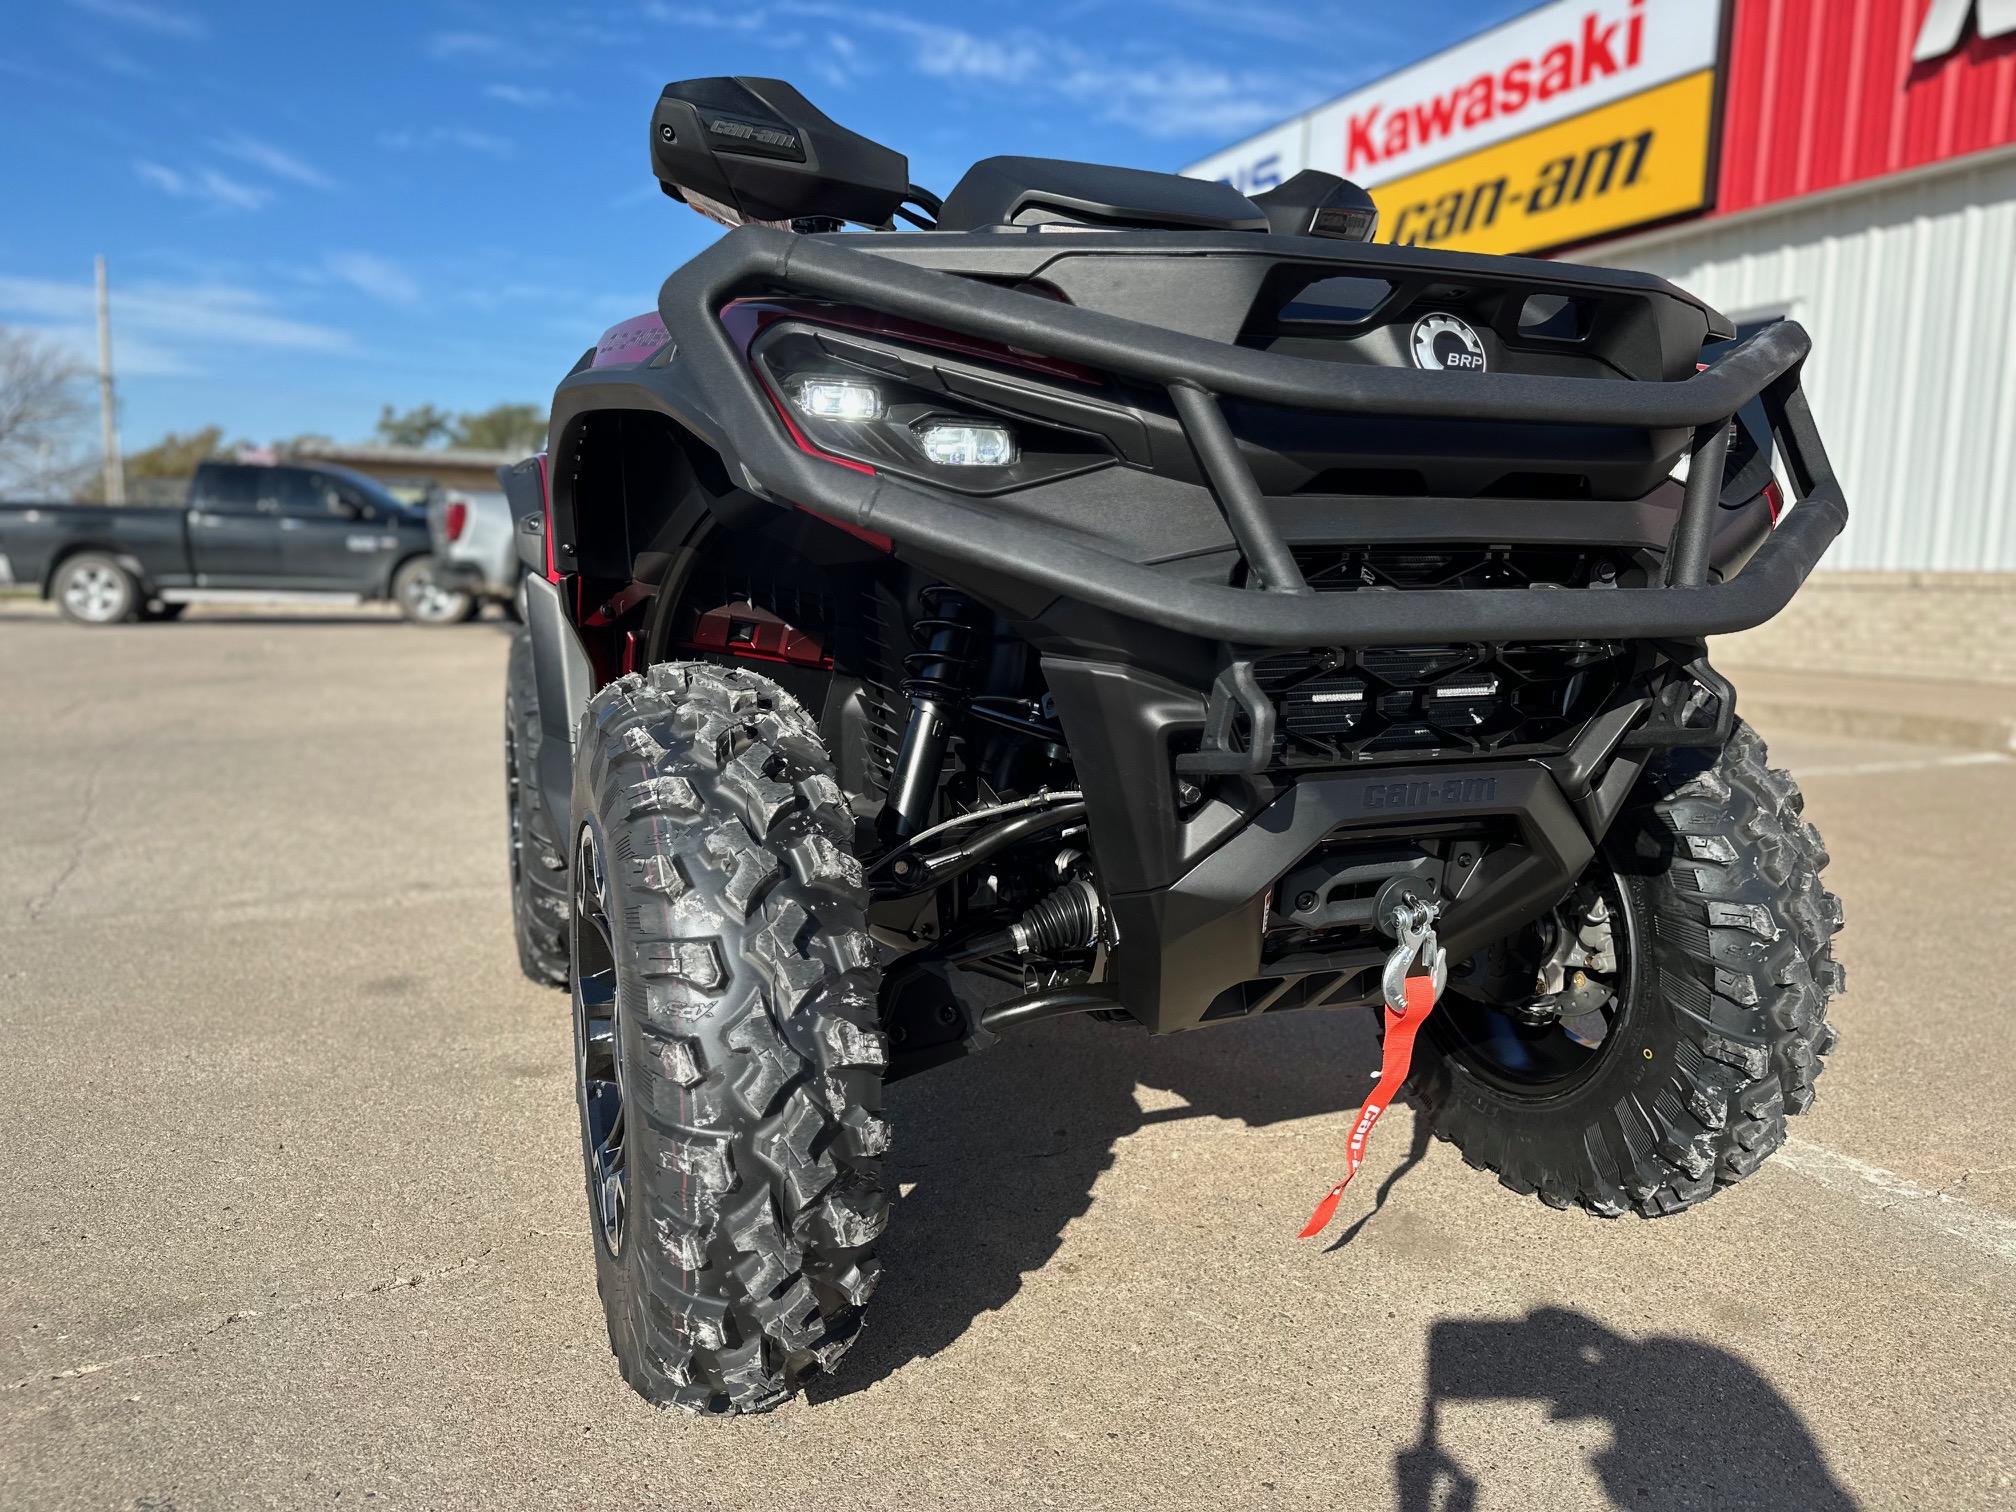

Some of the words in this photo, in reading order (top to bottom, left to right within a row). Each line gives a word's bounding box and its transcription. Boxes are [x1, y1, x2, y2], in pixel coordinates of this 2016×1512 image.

[1344, 0, 1645, 174] Kawasaki
[710, 119, 795, 148] can-am
[1388, 130, 1654, 246] can-am
[1446, 352, 1483, 369] BRP
[1362, 777, 1497, 810] can-am
